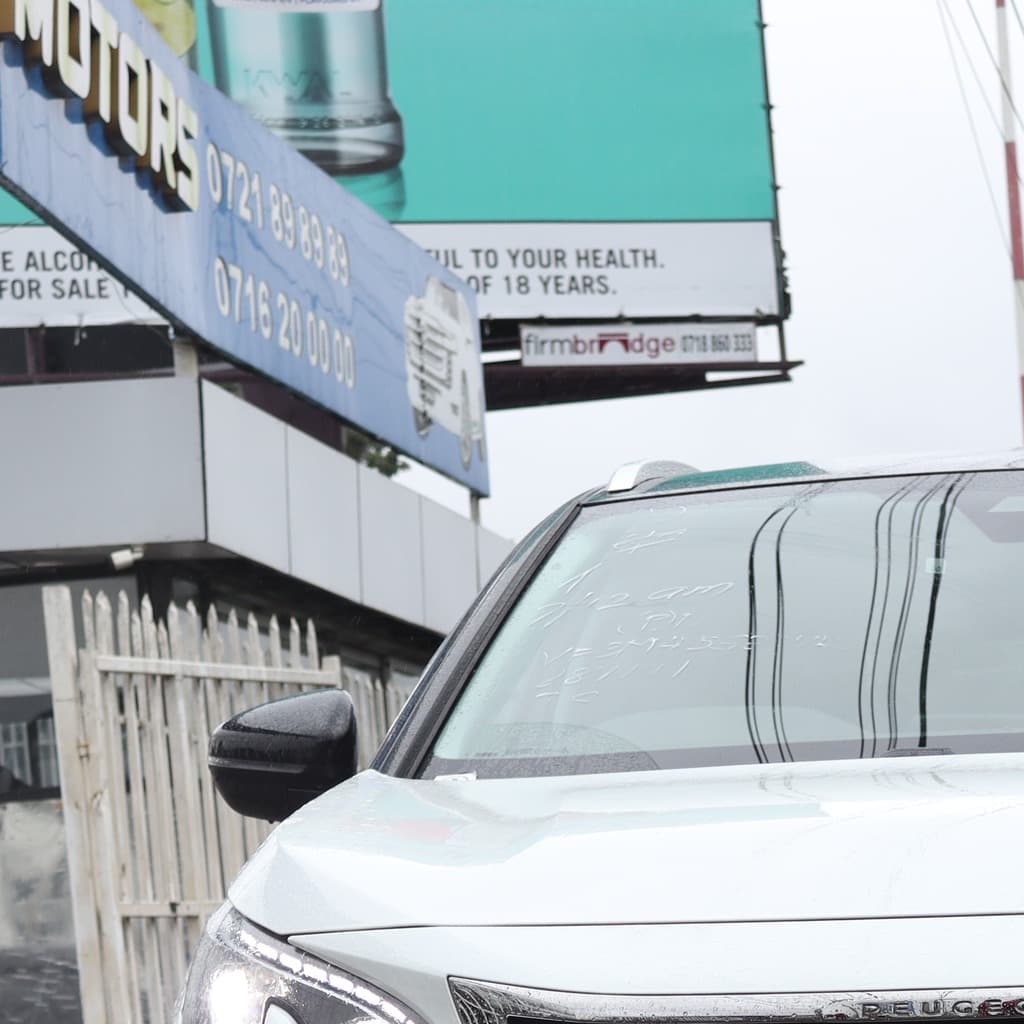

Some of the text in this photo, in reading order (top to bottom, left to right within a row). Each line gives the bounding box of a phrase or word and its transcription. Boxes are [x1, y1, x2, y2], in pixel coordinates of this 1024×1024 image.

[14, 0, 198, 212] MOTORS
[207, 142, 350, 288] 0721 89 89 89
[425, 249, 463, 269] UL
[470, 249, 498, 269] TO
[507, 249, 567, 269] YOUR
[576, 248, 665, 269] HEALTH.
[51, 278, 110, 299] SALE
[466, 275, 493, 295] OF
[504, 275, 530, 295] 18
[538, 275, 617, 295] YEARS.
[214, 256, 273, 341] 0716
[277, 292, 302, 358] 20
[306, 312, 331, 376] 00
[333, 328, 354, 390] 00
